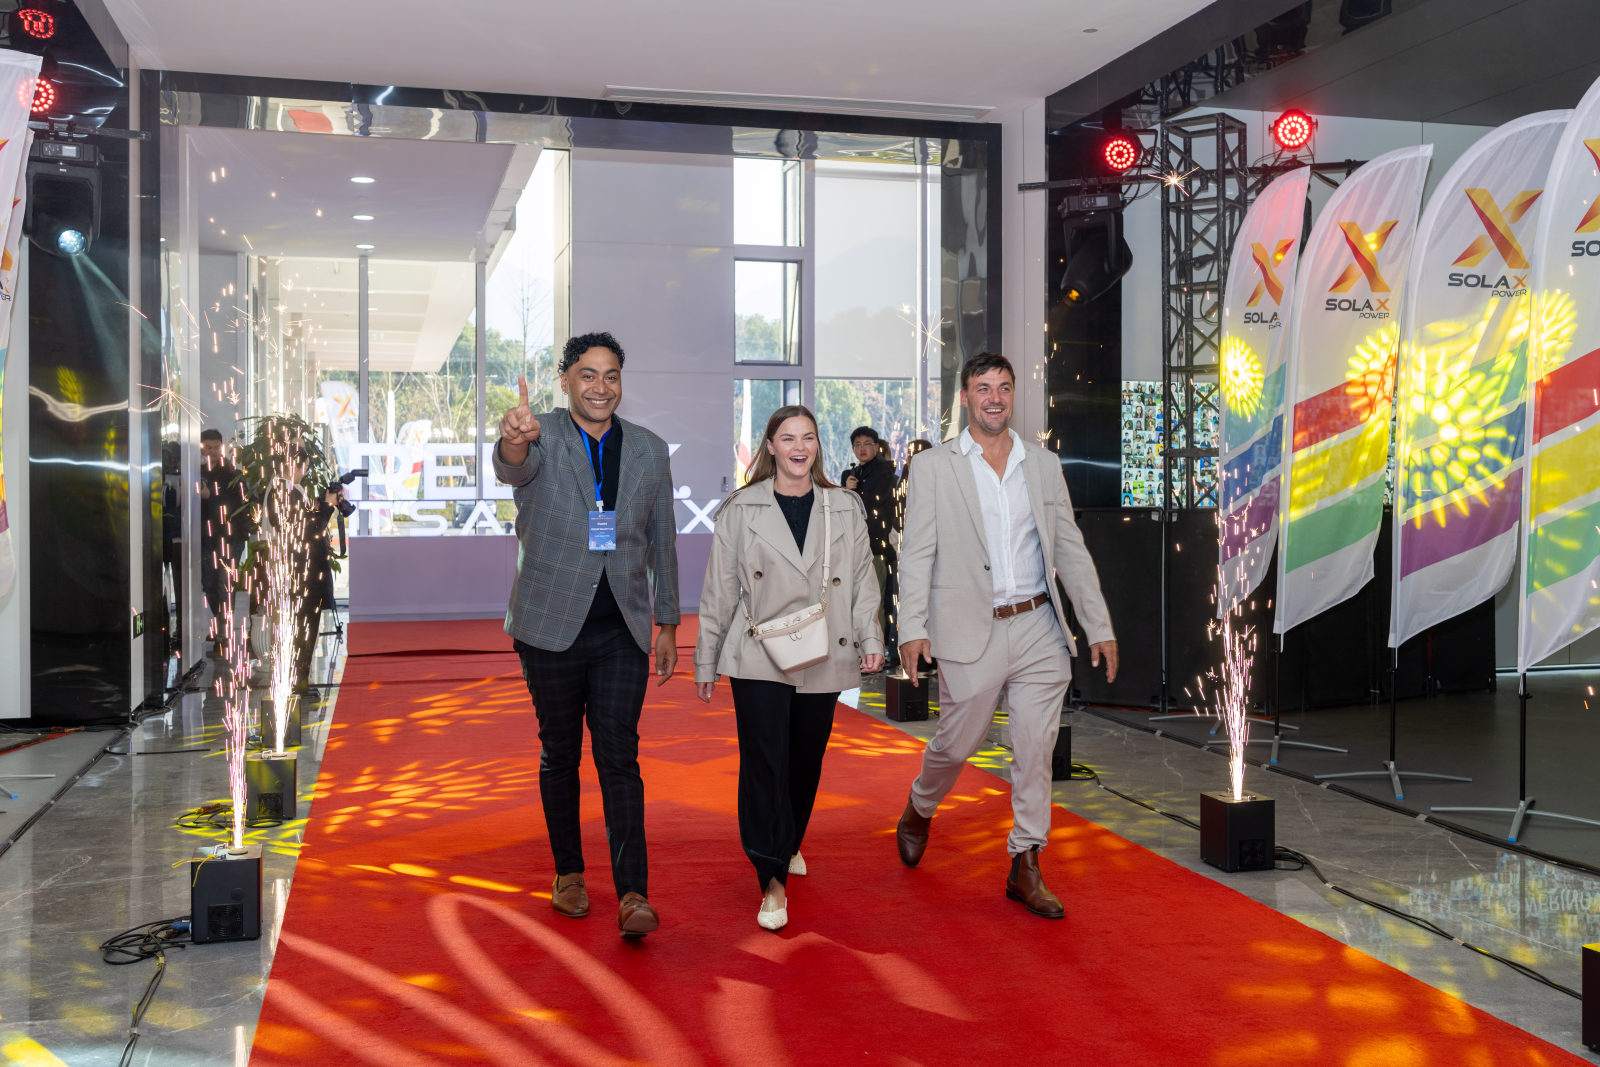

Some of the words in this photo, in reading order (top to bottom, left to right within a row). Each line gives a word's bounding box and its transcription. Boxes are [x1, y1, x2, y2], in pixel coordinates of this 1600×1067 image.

[1448, 273, 1528, 289] SOLAX
[1491, 288, 1528, 298] POWER
[1325, 298, 1390, 311] SOLAX
[1243, 311, 1280, 324] SOLA
